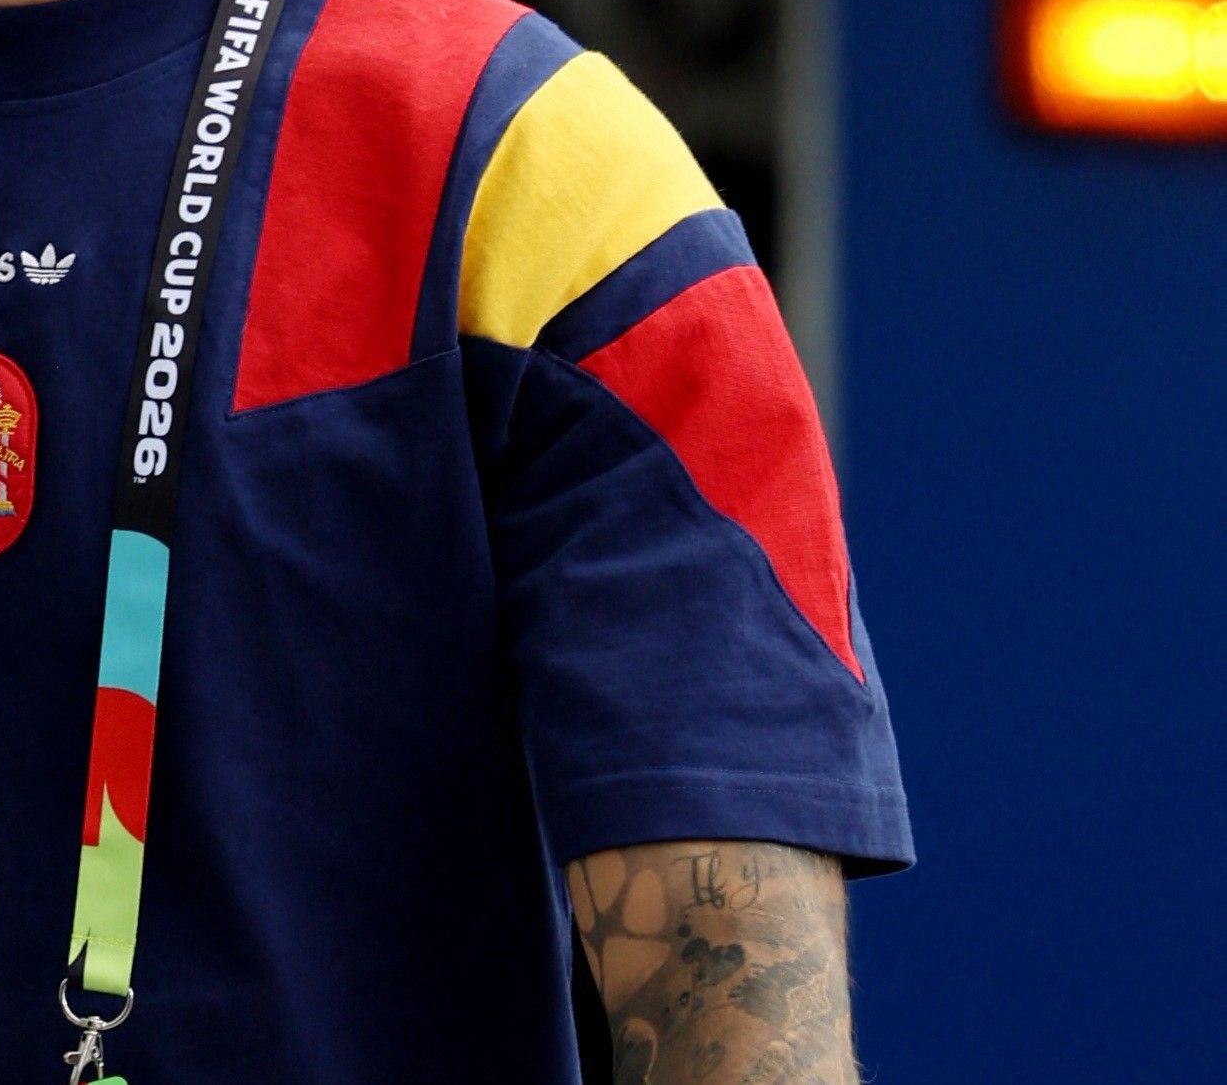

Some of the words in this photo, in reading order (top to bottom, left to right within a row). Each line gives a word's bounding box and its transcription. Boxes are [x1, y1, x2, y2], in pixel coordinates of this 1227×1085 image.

[178, 79, 244, 224] WORLD
[159, 231, 203, 315] CUP
[133, 322, 185, 477] 2026
